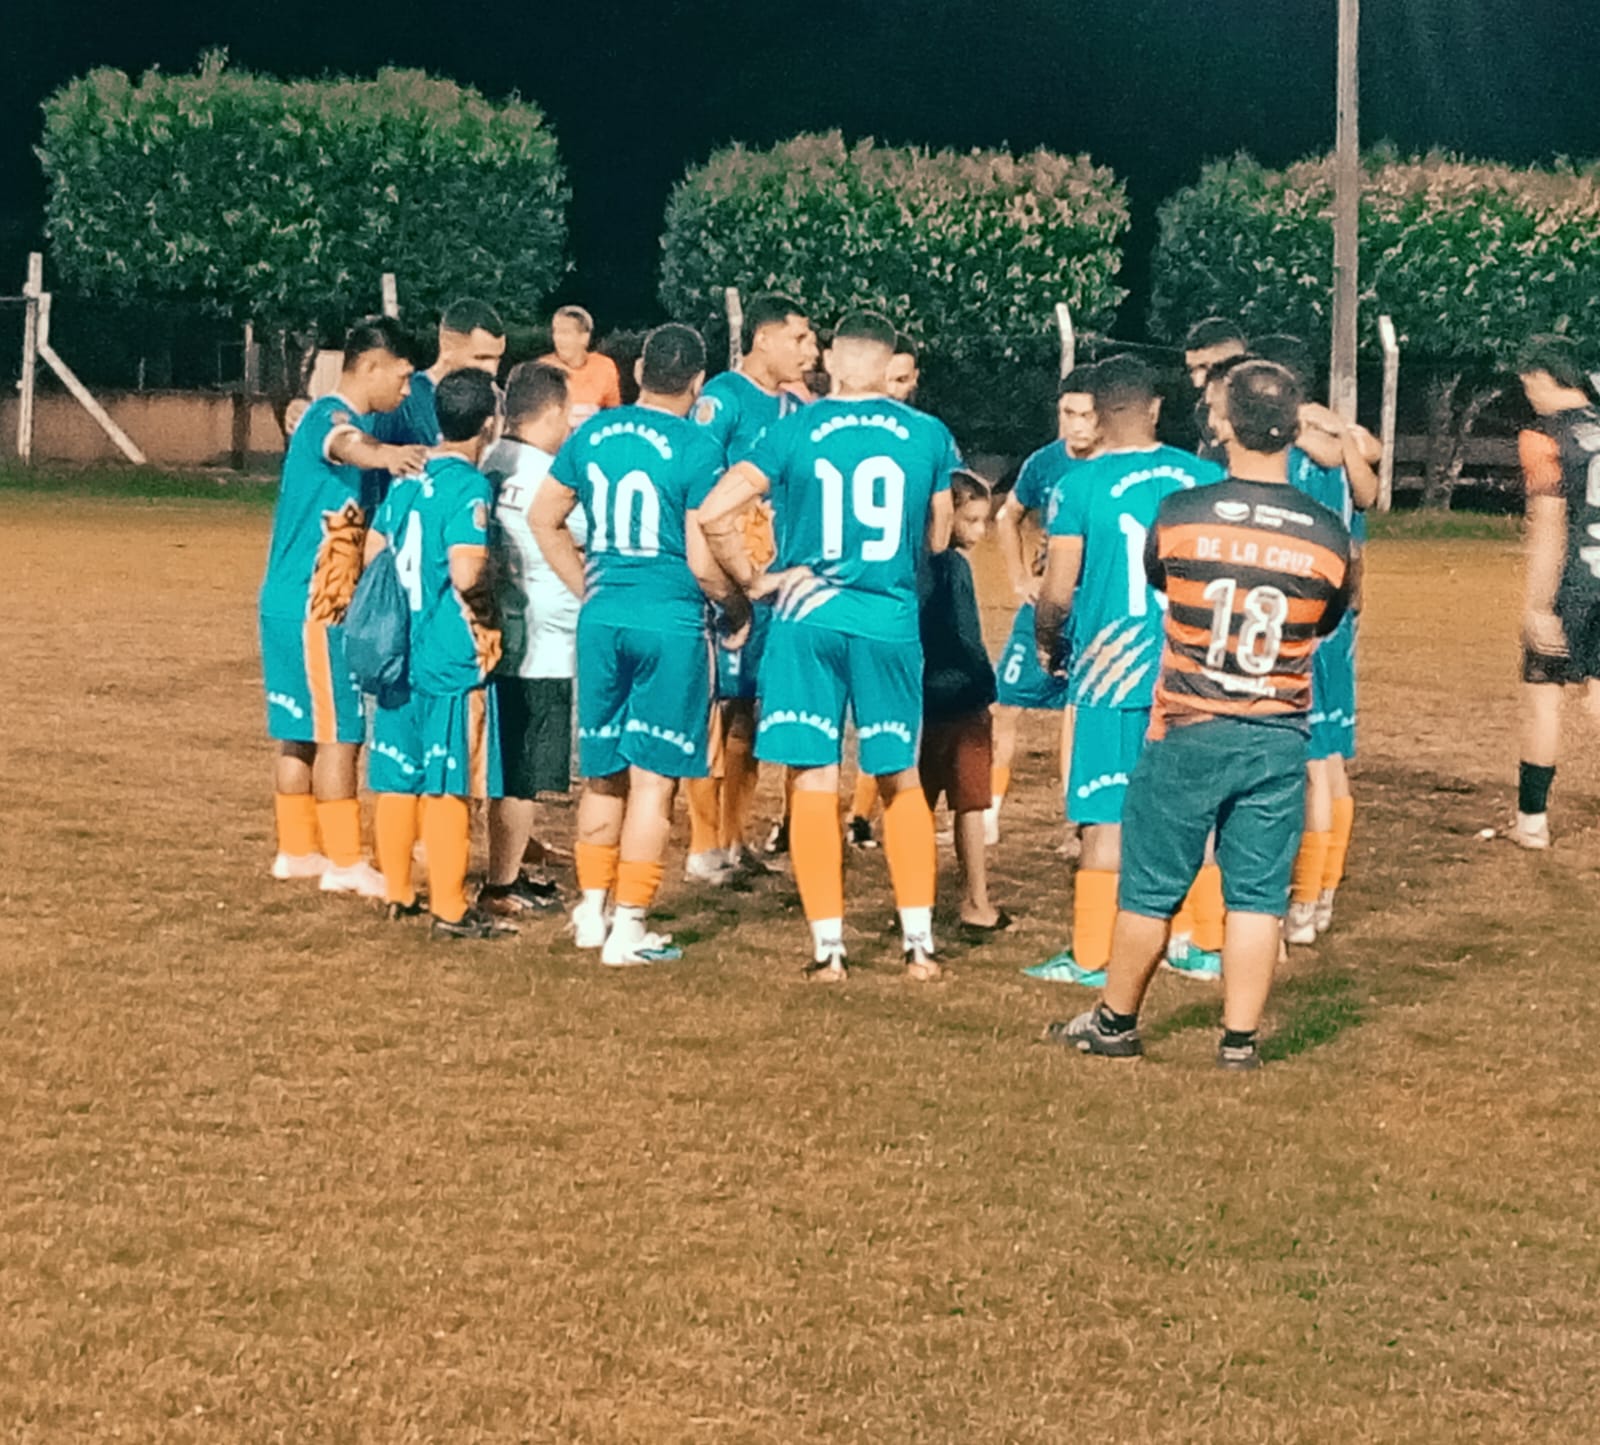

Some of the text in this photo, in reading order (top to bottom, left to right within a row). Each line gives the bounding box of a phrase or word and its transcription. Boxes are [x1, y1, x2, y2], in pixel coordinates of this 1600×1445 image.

[587, 462, 660, 557] 10
[814, 455, 905, 561] 19
[1197, 536, 1314, 576] DE LA CRUZ
[1004, 654, 1024, 684] 6
[1203, 578, 1288, 675] 18
